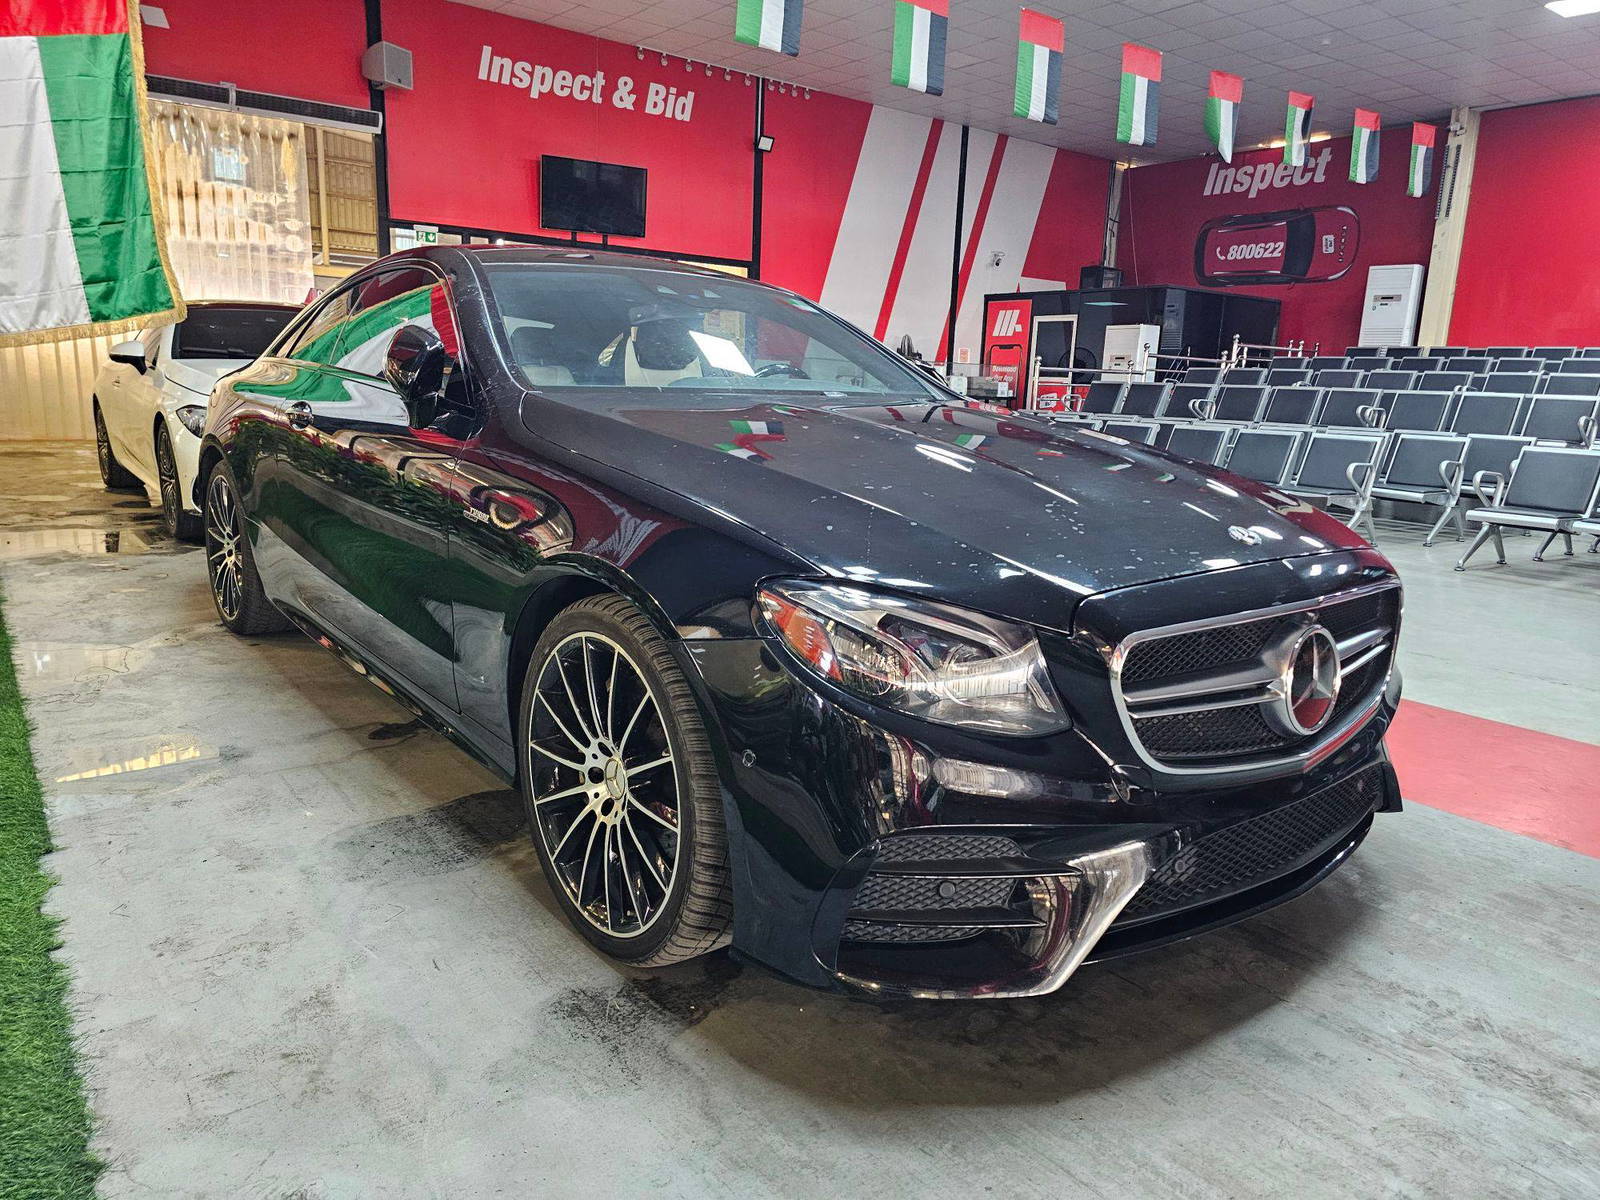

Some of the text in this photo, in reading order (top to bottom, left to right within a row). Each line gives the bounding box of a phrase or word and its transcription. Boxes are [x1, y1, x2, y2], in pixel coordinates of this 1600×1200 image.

[478, 45, 695, 122] Inspect & Bid
[1203, 147, 1332, 199] Inspect
[1227, 241, 1284, 261] 800622
